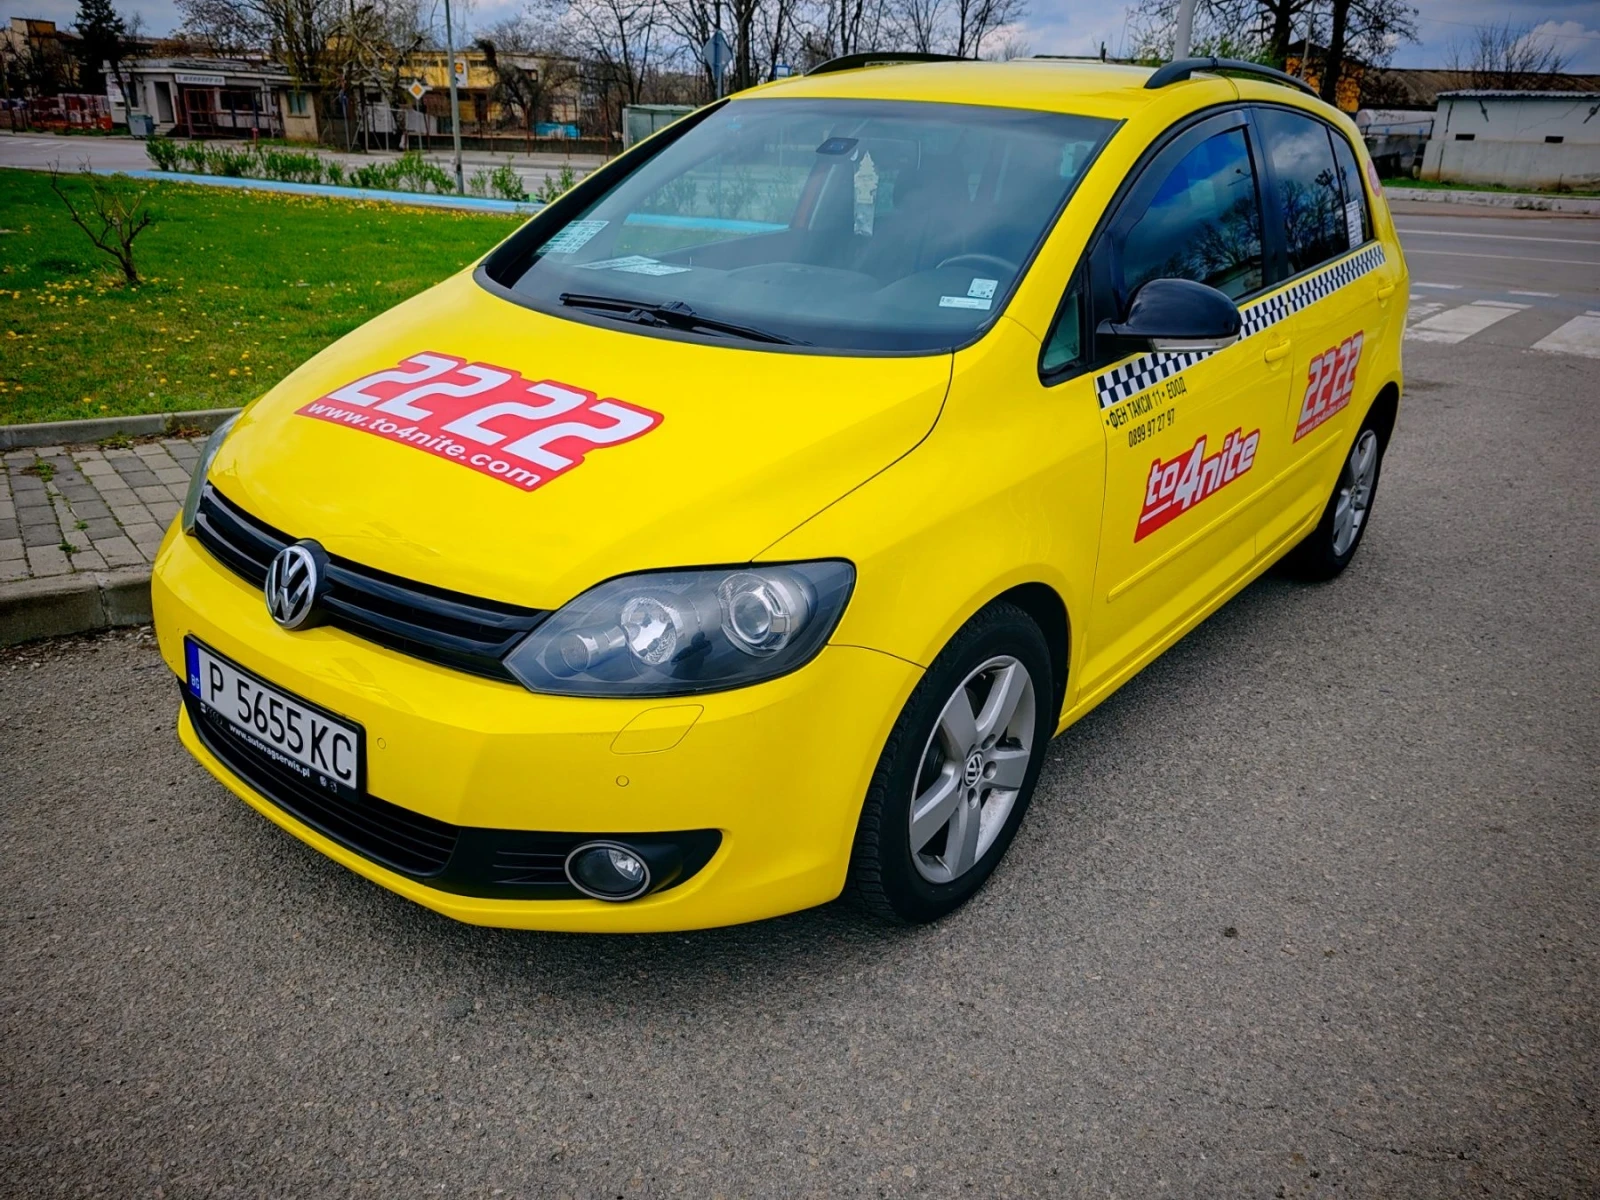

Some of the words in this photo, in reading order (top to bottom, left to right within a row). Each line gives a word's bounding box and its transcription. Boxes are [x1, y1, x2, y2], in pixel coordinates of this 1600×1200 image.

[1126, 393, 1153, 419] ТАКСИ
[1166, 377, 1187, 399] ЕООД
[1128, 423, 1146, 448] 0899
[1147, 418, 1156, 438] 97
[1157, 413, 1165, 432] 27
[1166, 407, 1175, 427] 97
[308, 402, 542, 487] www.to4nite.com
[1145, 433, 1259, 510] to4nite
[191, 674, 200, 690] BG
[209, 661, 224, 702] P
[237, 678, 304, 754] 5655
